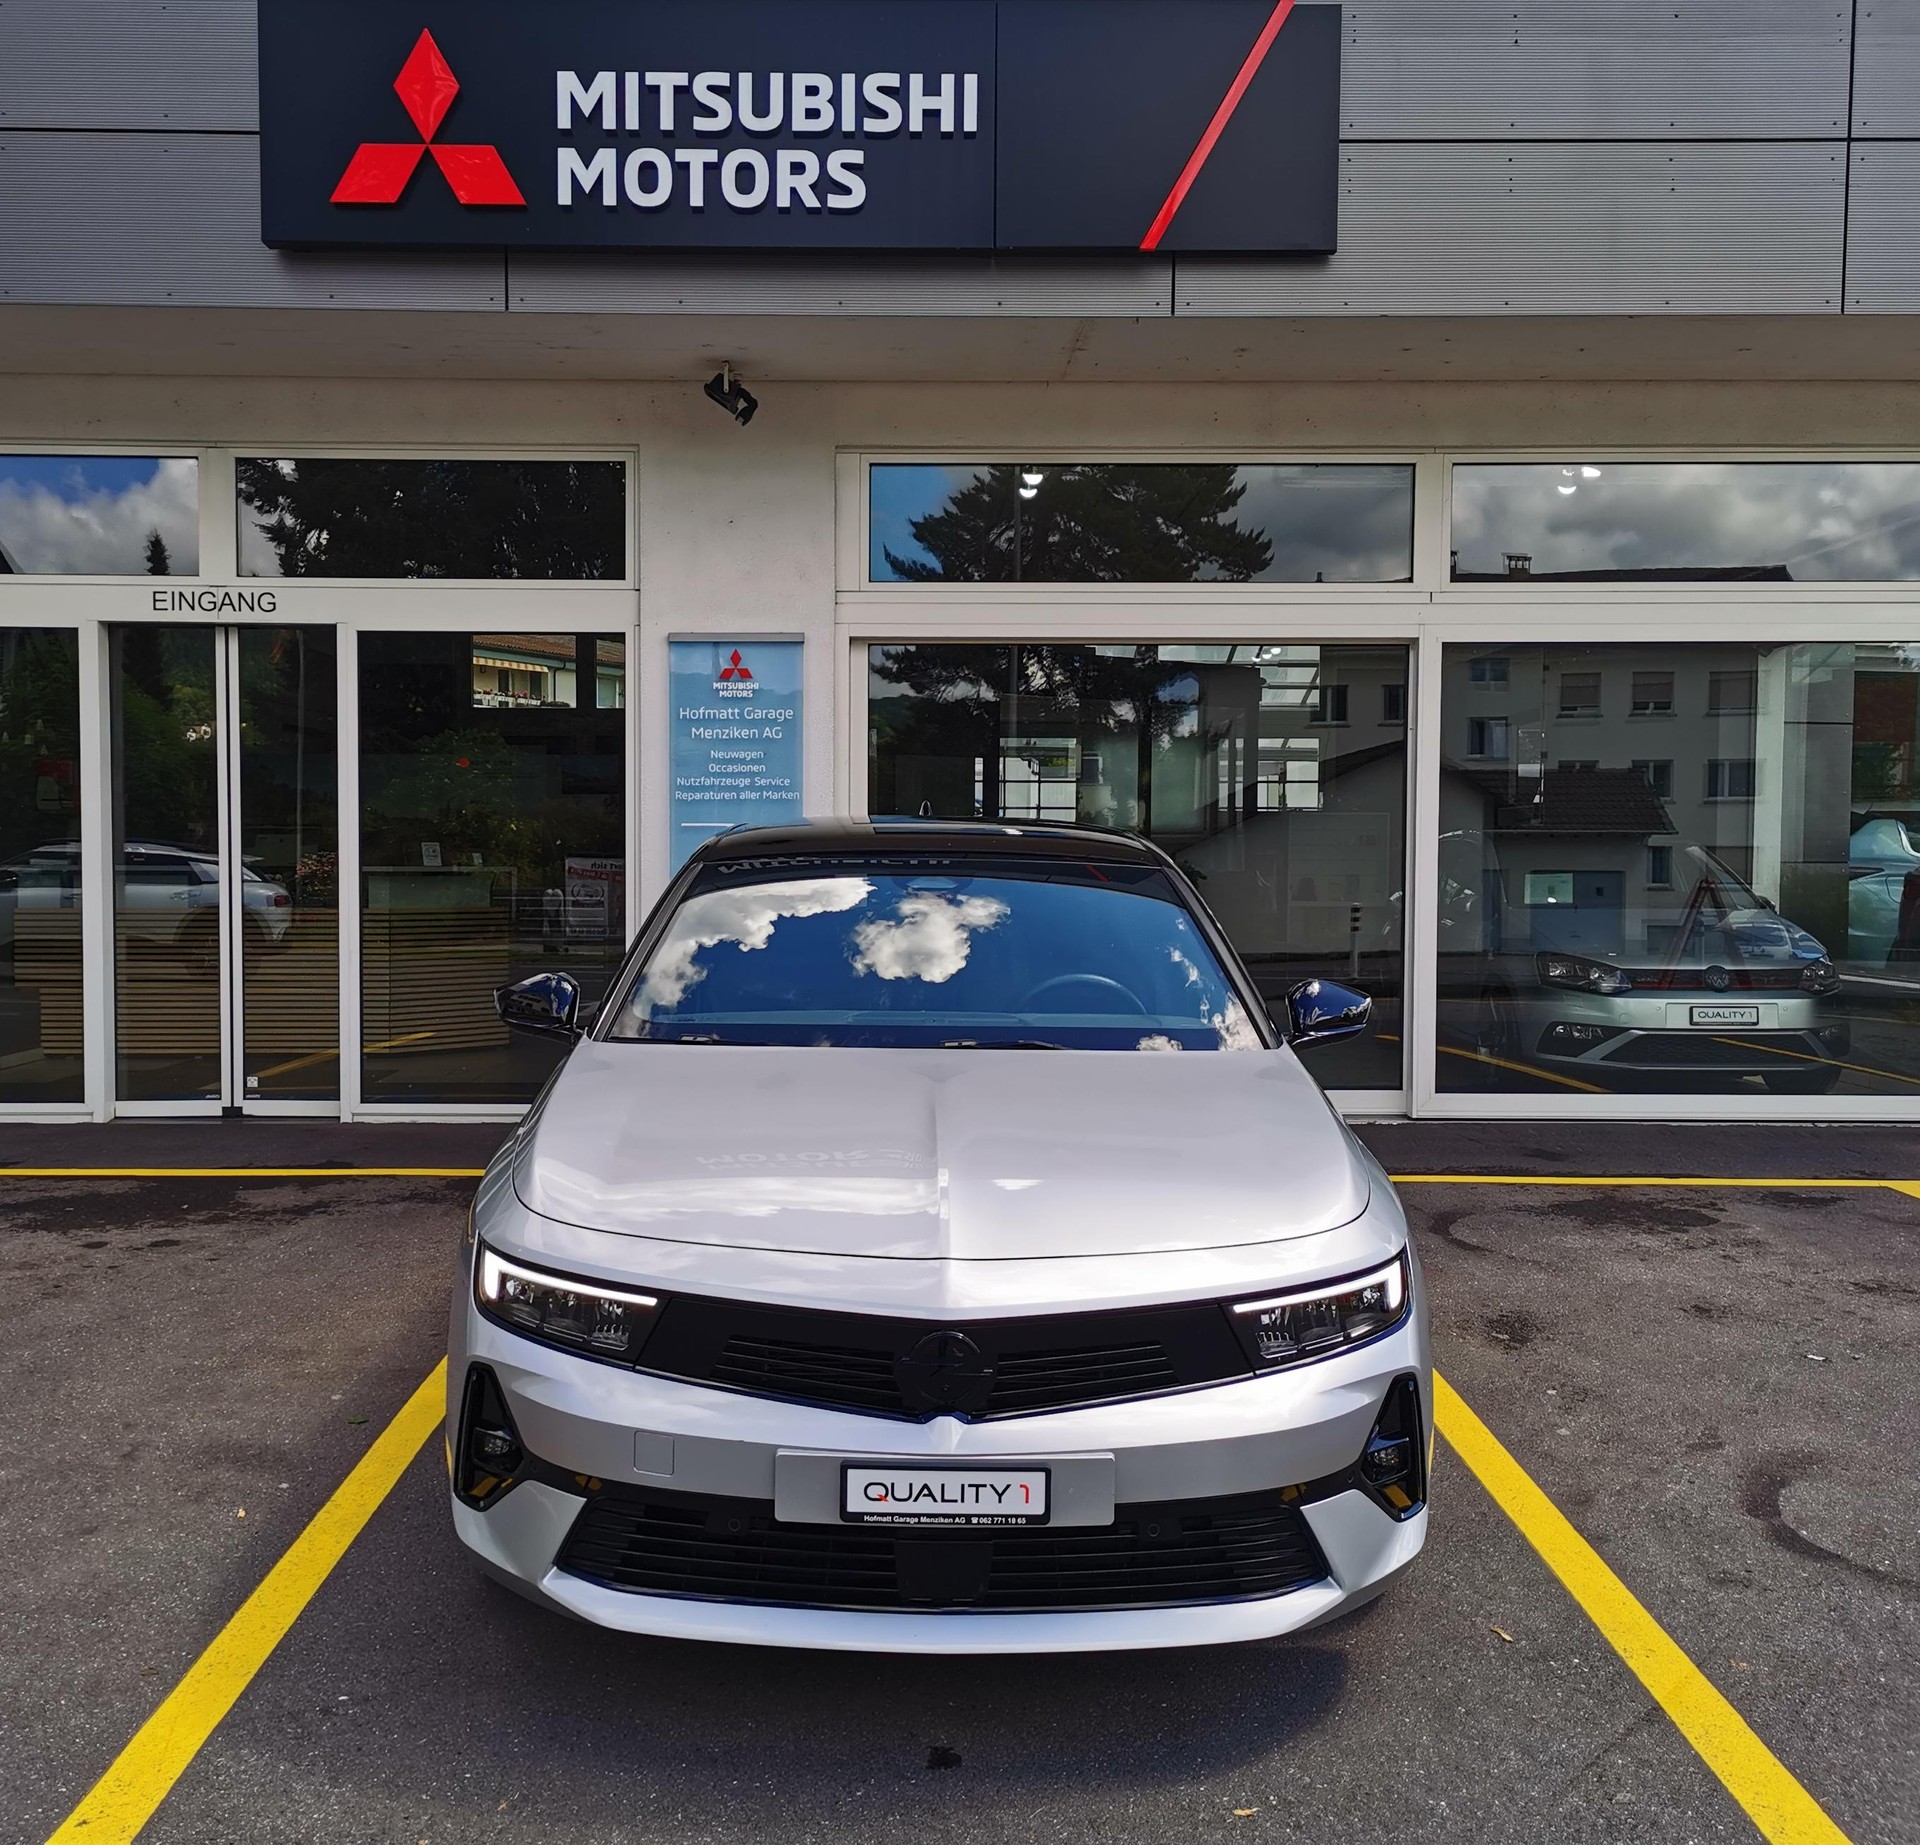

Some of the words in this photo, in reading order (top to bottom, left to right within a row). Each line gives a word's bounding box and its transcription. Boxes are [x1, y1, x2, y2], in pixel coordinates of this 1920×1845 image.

[556, 70, 978, 133] MITSUBISHI
[557, 147, 867, 209] MOTORS
[152, 590, 277, 613] EINGANG
[713, 682, 759, 690] MITSUBISHI
[719, 690, 753, 698] MOTORS
[679, 707, 740, 720] Hofmatt
[744, 707, 794, 722] Garage
[691, 727, 759, 739] Menziken
[762, 727, 782, 739] AG
[710, 750, 764, 761] Neuwagen
[708, 763, 766, 773] Occasionen
[676, 776, 751, 787] Nutzfahrzeuge
[754, 776, 791, 786] Service
[675, 791, 737, 802] Reparaturen
[739, 791, 761, 800] aller
[763, 791, 800, 800] Marken
[863, 1482, 1012, 1504] QUALITY
[1019, 1484, 1030, 1504] 1
[863, 1514, 892, 1523] Hofmatt
[893, 1515, 919, 1524] Garage
[920, 1516, 953, 1524] Menziken
[979, 1517, 992, 1525] 062
[993, 1517, 1006, 1525] 771
[1007, 1517, 1016, 1525] 18
[1017, 1517, 1027, 1525] 65
